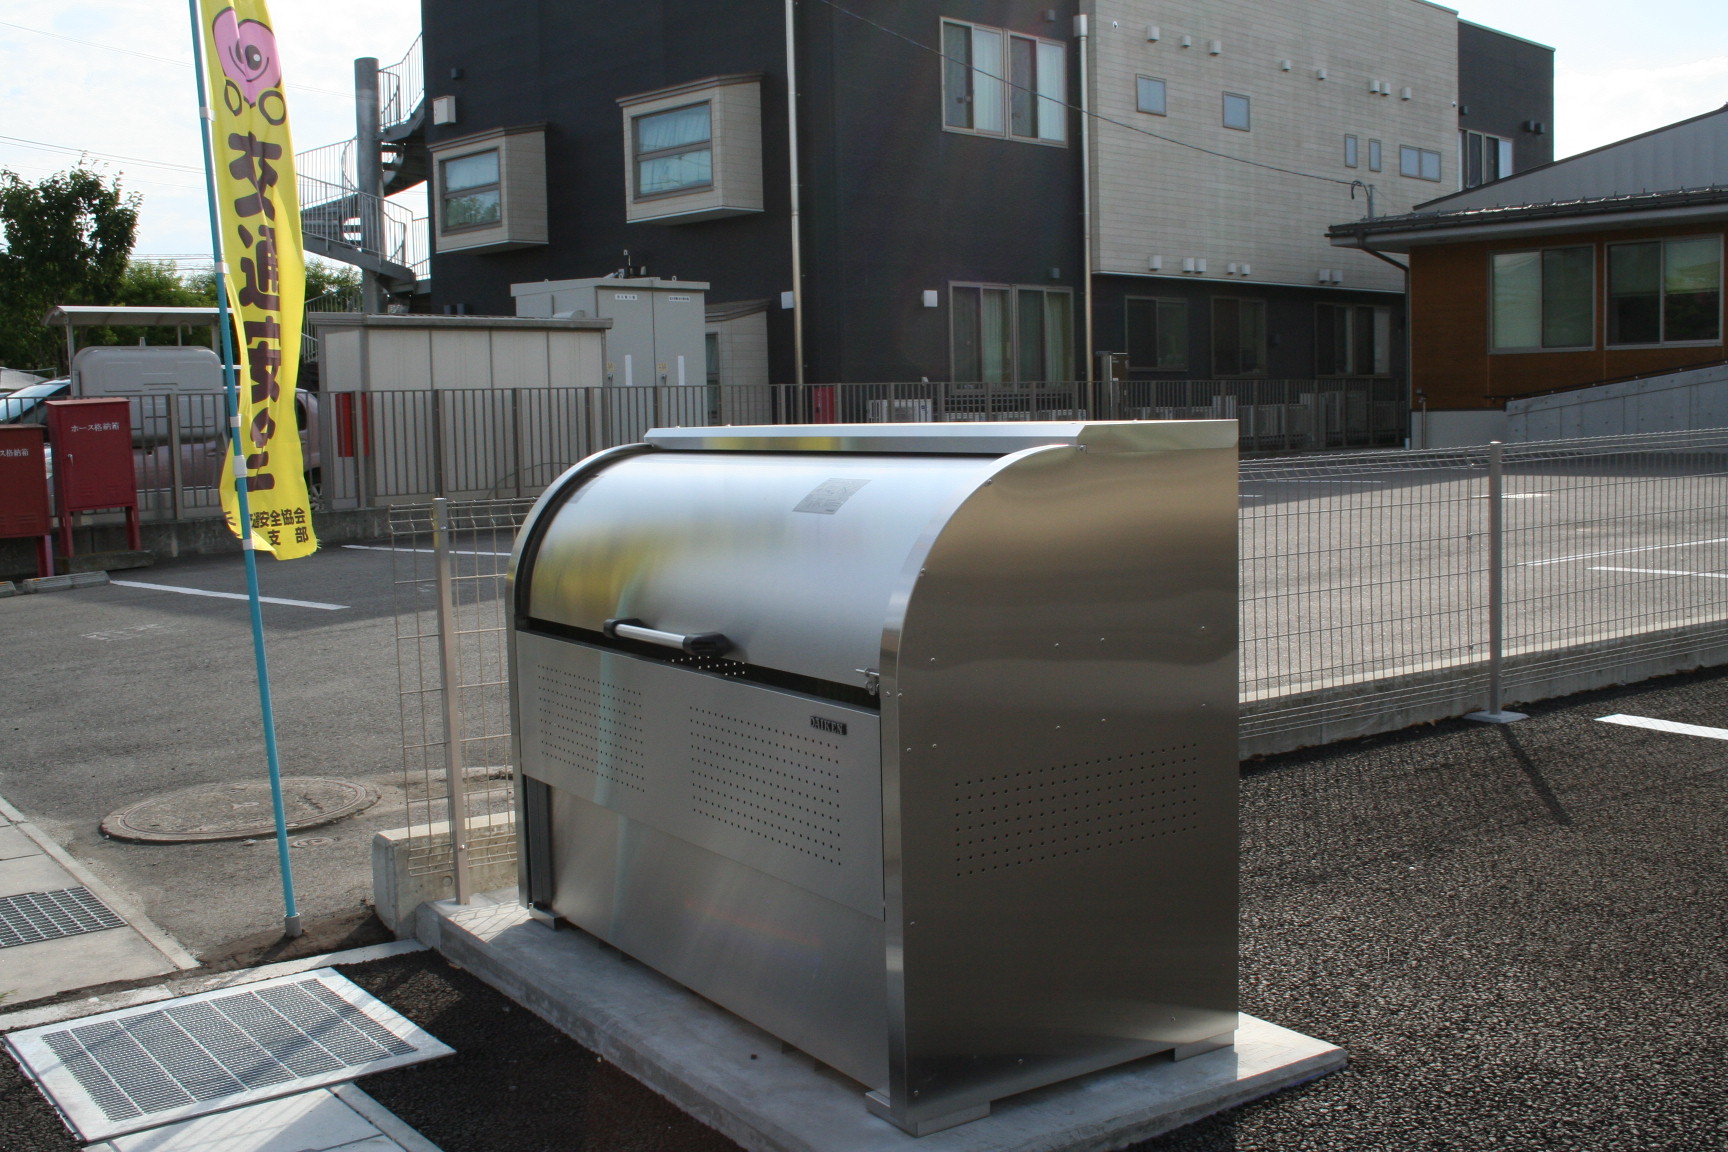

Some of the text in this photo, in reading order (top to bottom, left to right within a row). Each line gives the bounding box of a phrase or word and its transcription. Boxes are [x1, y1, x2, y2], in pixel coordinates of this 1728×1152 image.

[71, 421, 120, 432] ホース格納箱
[810, 716, 844, 736] DAIKEN
